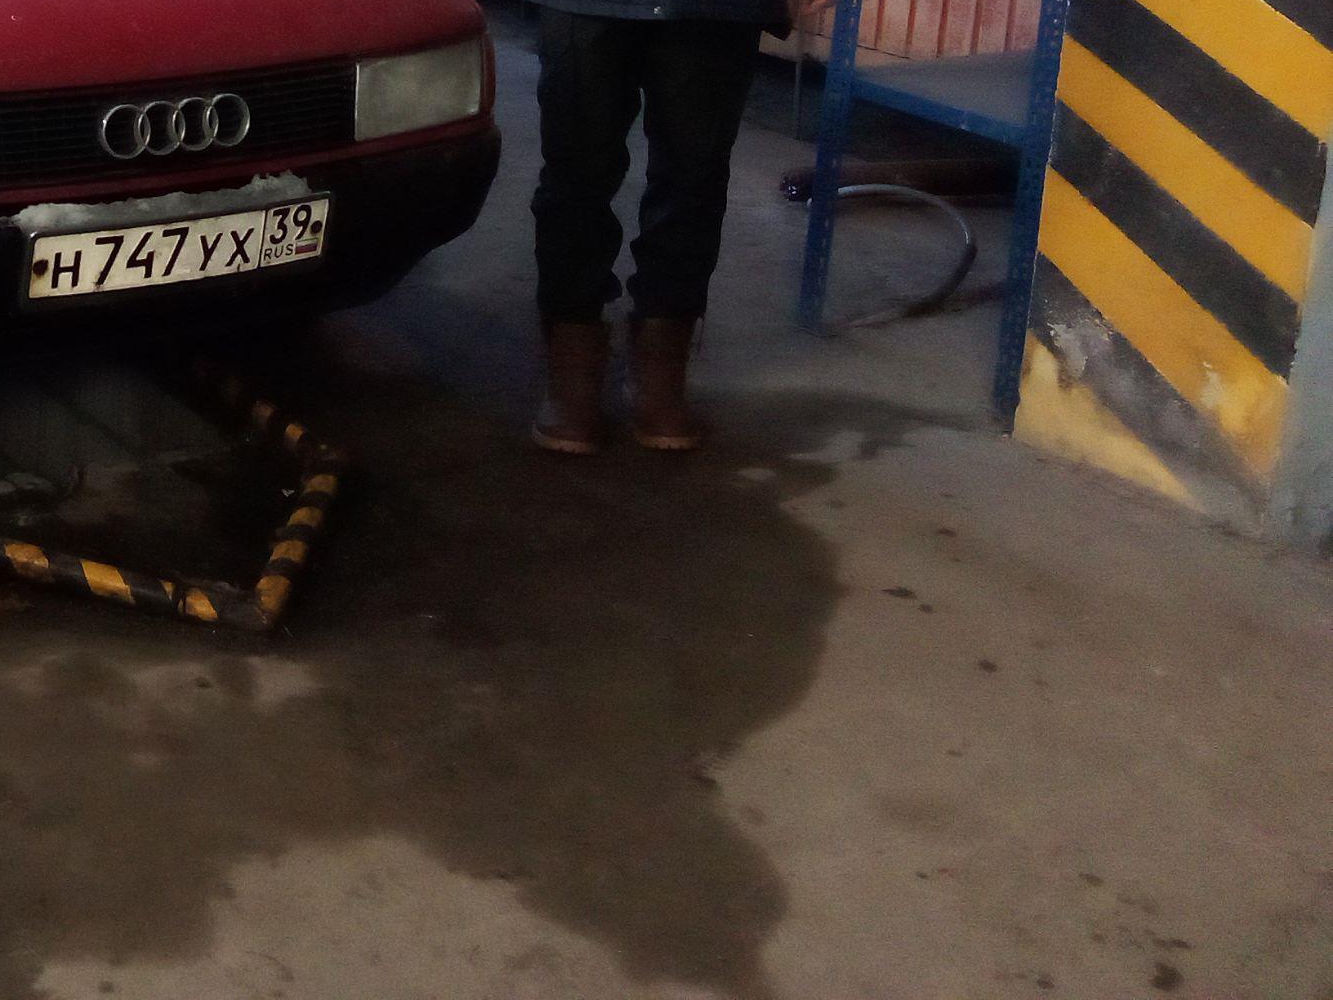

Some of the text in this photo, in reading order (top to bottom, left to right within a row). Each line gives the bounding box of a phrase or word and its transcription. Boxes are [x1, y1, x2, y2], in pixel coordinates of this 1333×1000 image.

[51, 204, 313, 289] Н747УХ 39
[263, 244, 294, 261] RUS
